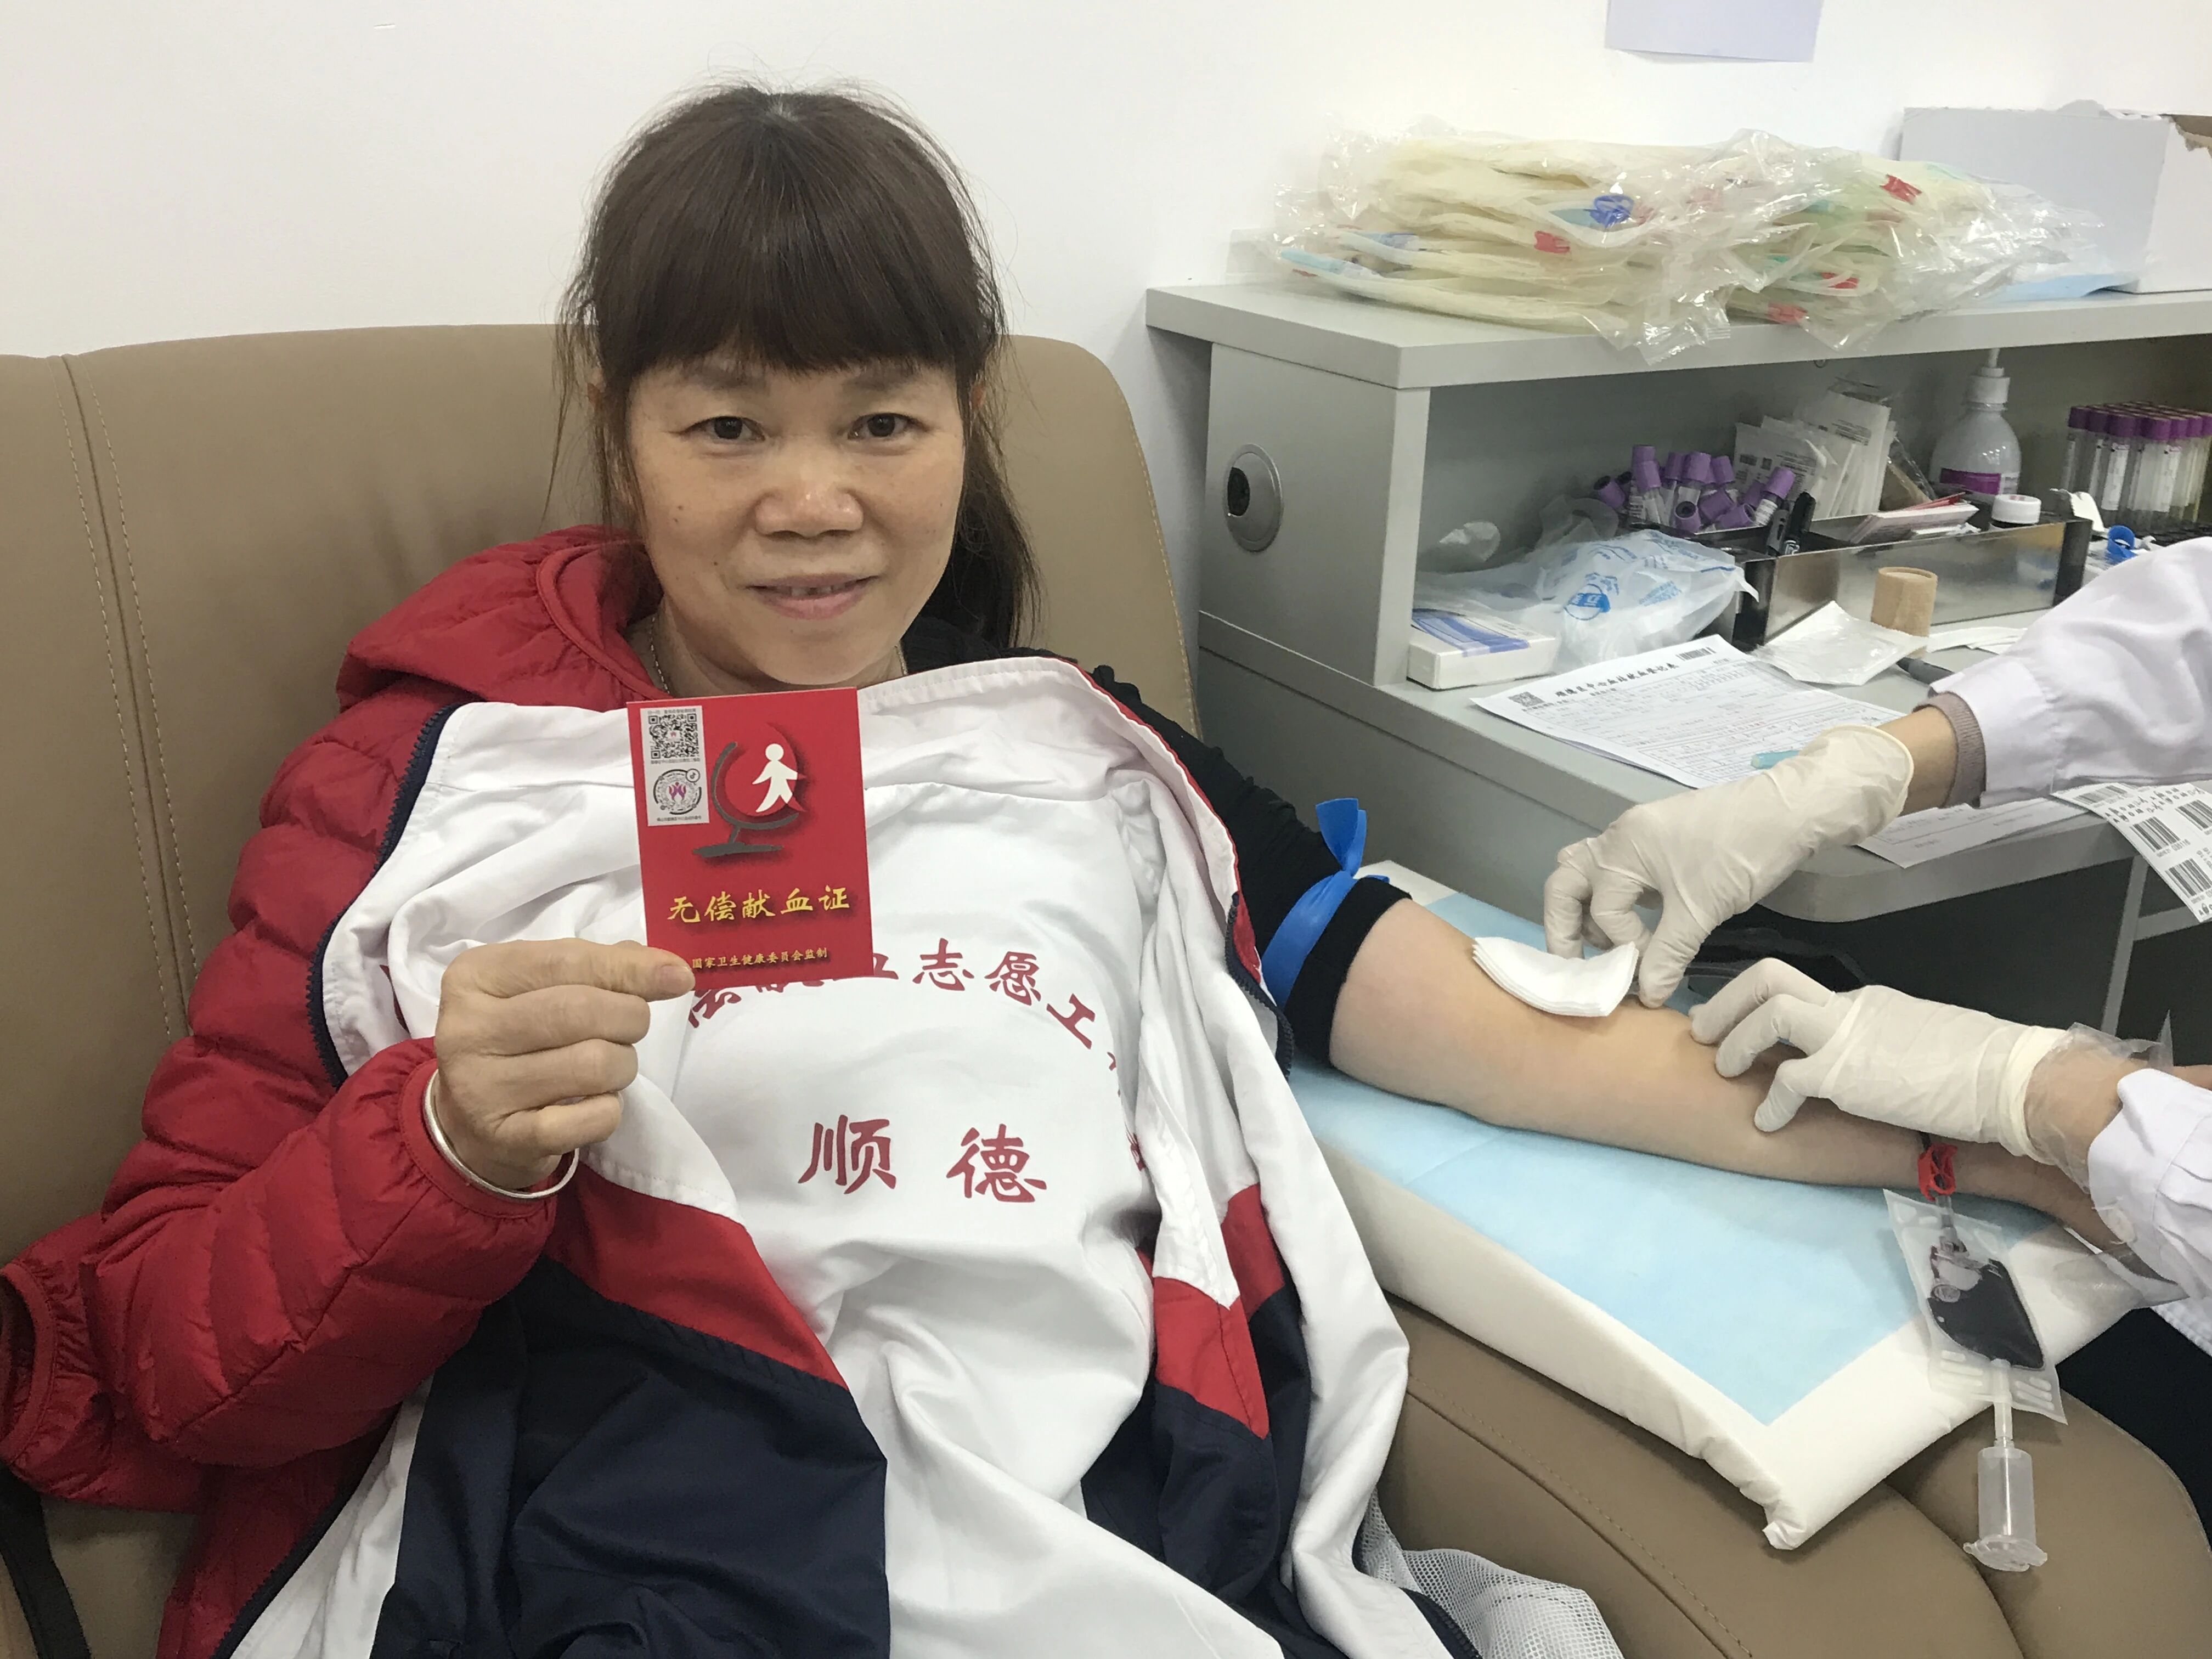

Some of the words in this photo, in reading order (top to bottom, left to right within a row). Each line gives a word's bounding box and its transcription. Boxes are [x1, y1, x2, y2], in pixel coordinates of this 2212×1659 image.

[667, 885, 851, 924] 无偿献血证
[692, 947, 828, 969] 国家卫生健康委员会监制
[797, 1114, 1047, 1203] 顺德
